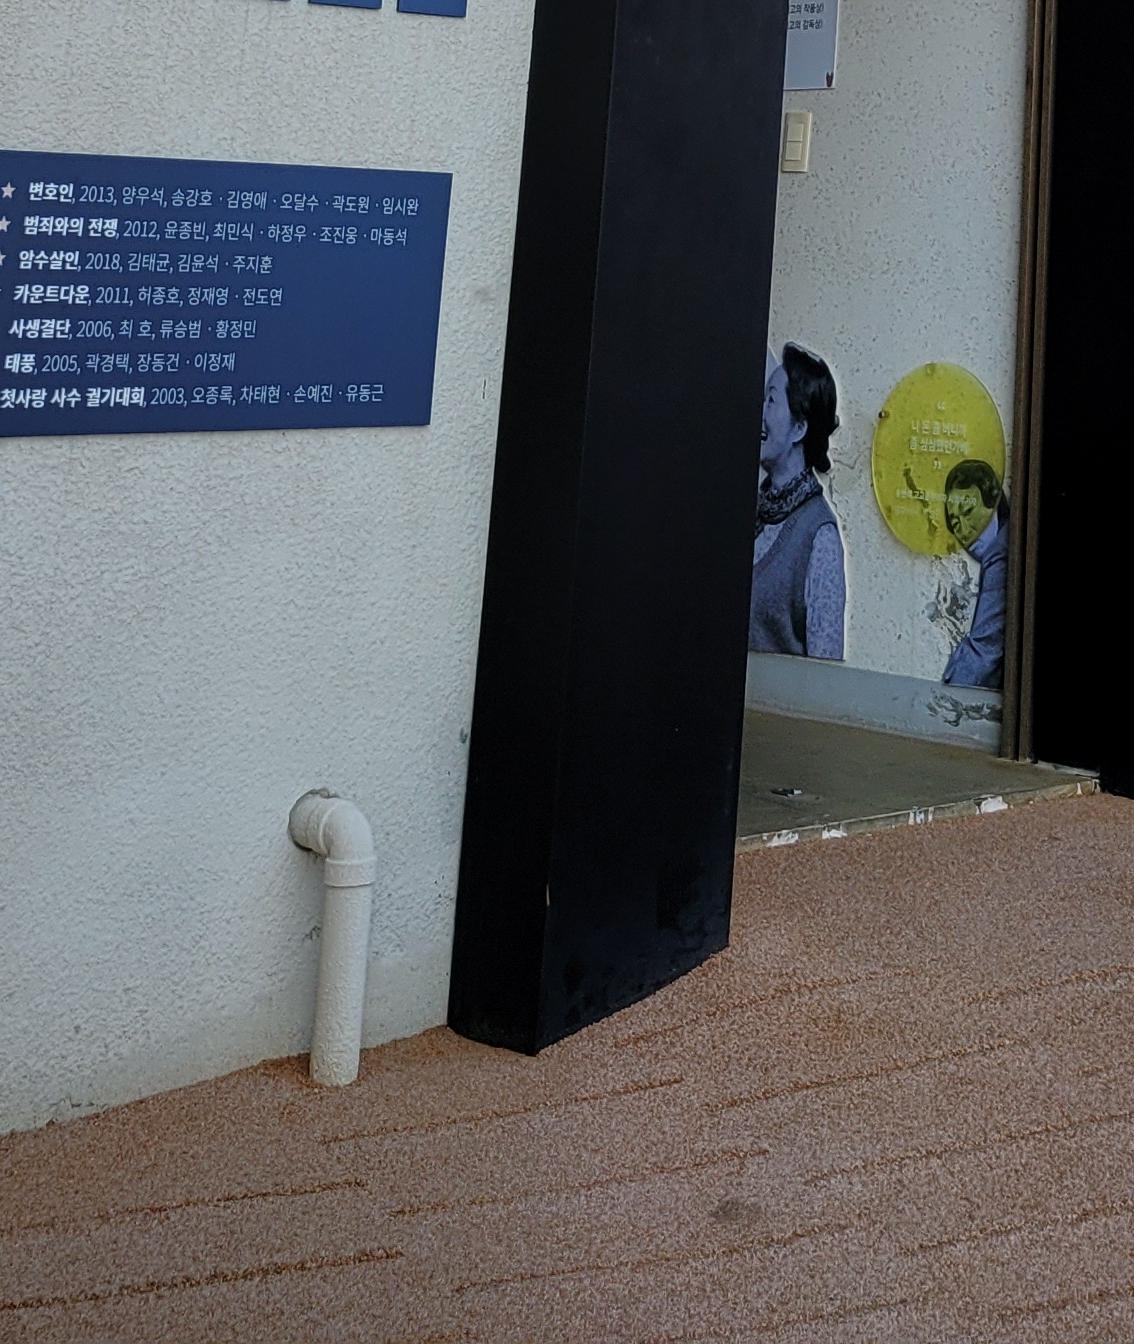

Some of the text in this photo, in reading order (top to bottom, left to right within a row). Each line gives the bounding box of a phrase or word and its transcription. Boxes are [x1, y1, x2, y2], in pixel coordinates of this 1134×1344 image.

[29, 181, 419, 216] 변호인, 2013, 양우석, 송강호 김영애 오달수 곽도원 임시완
[23, 215, 407, 246] 범죄와의 전쟁, 2012, 윤종빈, 최민식 하정우 조진웅 마동석
[18, 249, 273, 274] 암수살인, 2018, 김태균, 김윤석 주지훈
[13, 283, 283, 307] 카운트다운, 2011, 허종호, 정재영 전도연
[8, 318, 256, 340] 사생결단, 2006, 최 호, 류승범 황정민
[4, 352, 236, 375] 태풍, 2005, 곽경택, 장동건 이정재
[0, 383, 384, 409] 첫사랑 사수 궐기대회, 2003, 오종록, 차태현 손예진 유동근
